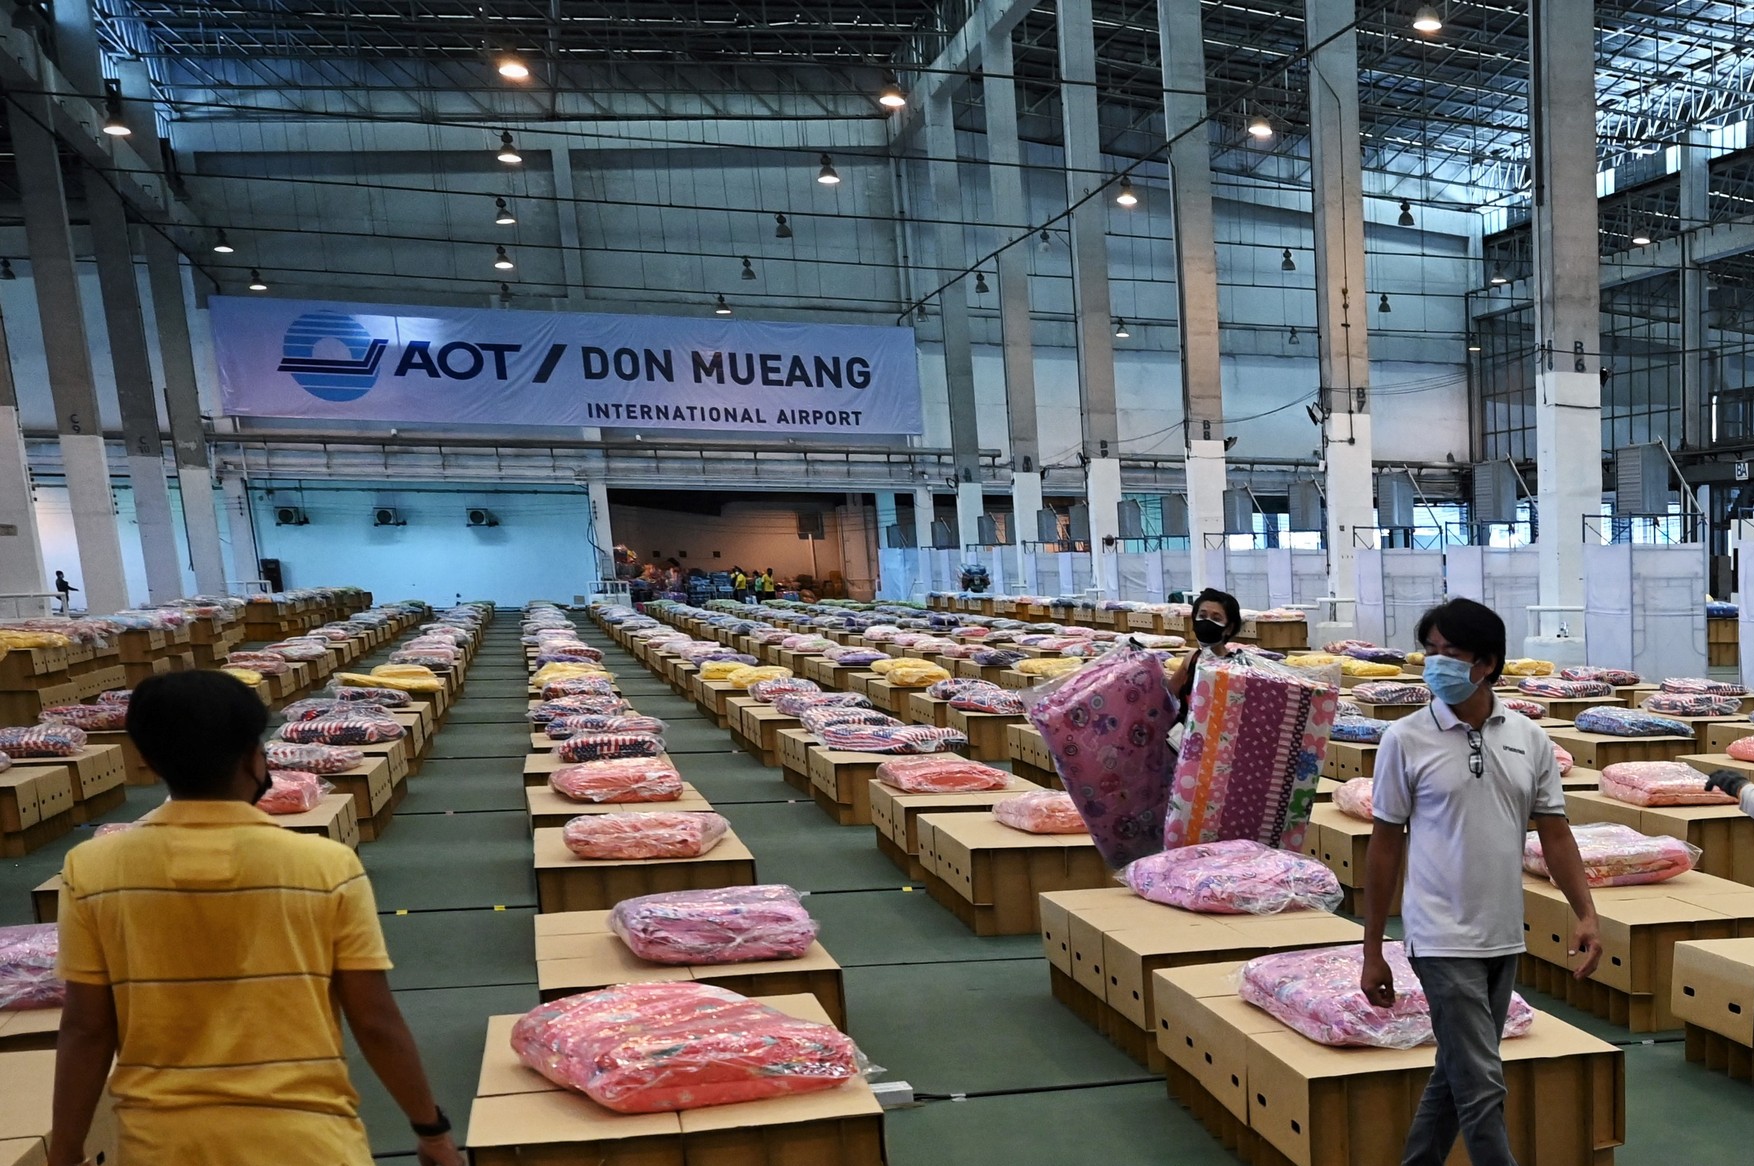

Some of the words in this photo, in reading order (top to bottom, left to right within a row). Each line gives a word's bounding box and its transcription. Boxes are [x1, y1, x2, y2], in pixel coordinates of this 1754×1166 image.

[394, 341, 522, 380] AOT
[581, 346, 674, 382] DON
[691, 350, 871, 389] MUEANG
[587, 403, 766, 424] INTERNATIONAL
[777, 409, 862, 426] AIRPORT
